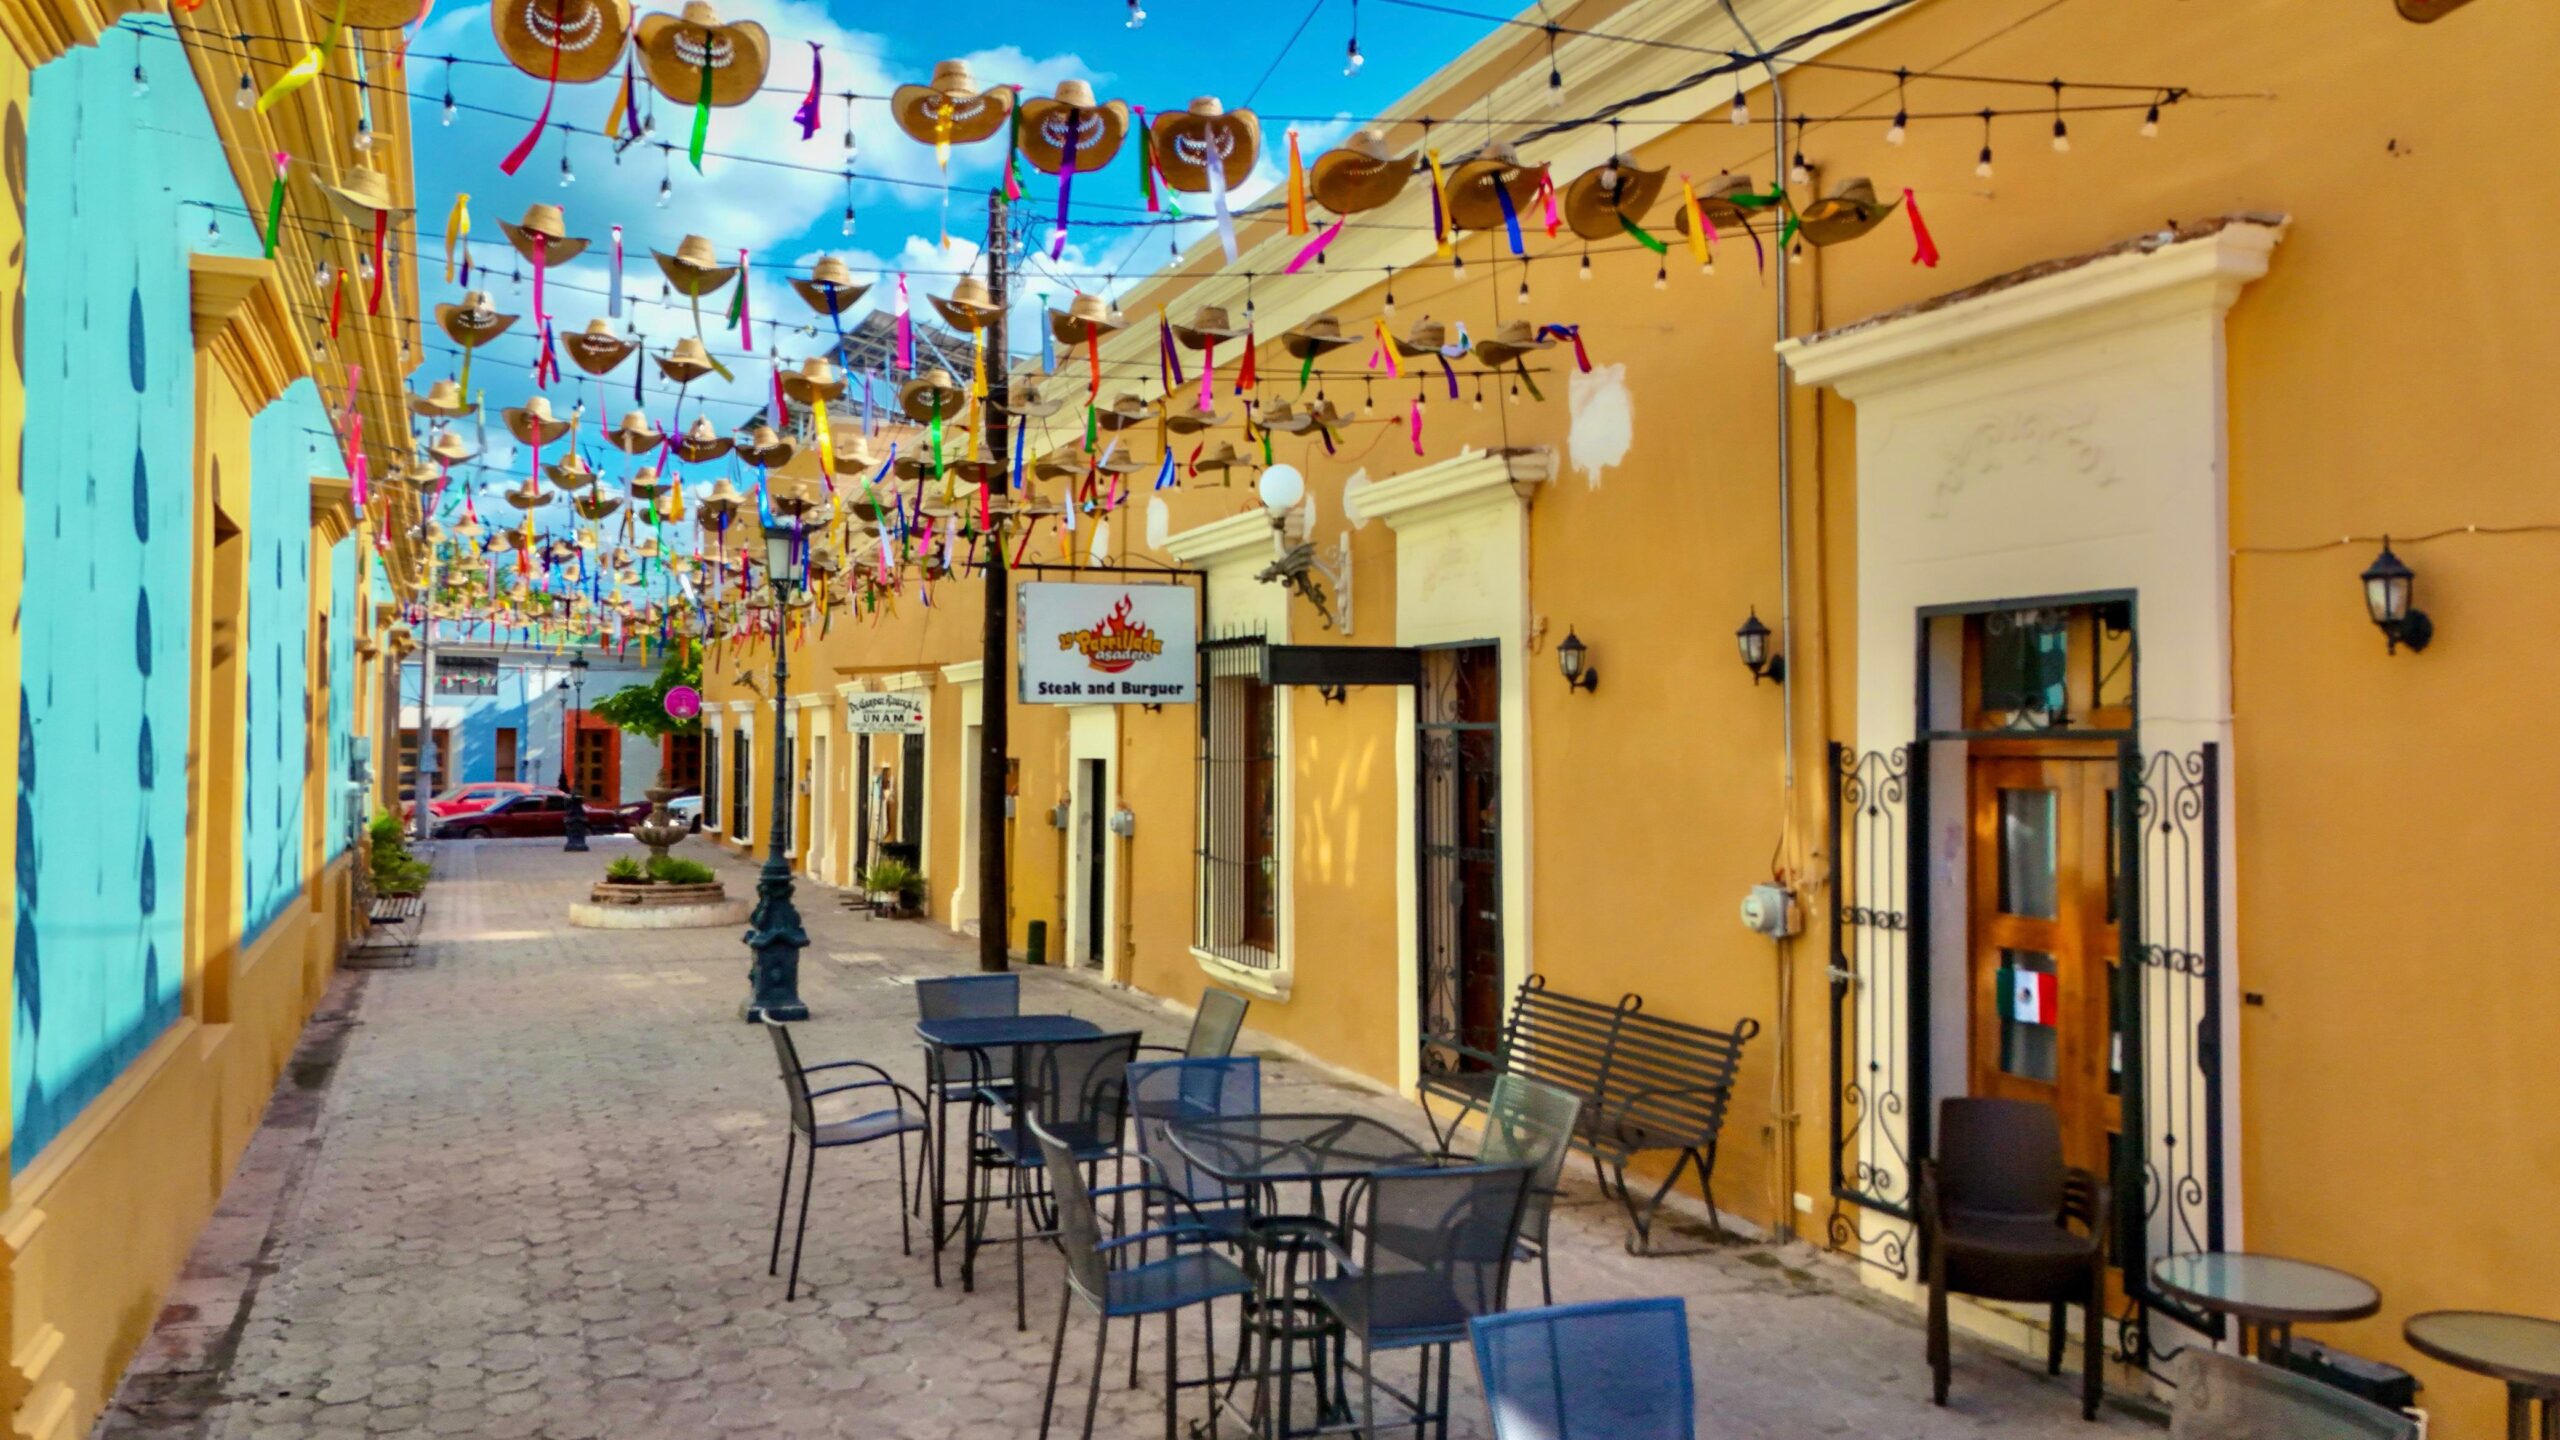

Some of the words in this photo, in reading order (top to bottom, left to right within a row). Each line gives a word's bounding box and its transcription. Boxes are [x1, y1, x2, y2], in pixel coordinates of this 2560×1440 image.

[1074, 629, 1164, 655] Parrillada
[1038, 682, 1082, 695] Steak
[1088, 682, 1115, 695] and
[1122, 682, 1184, 697] Burguer
[863, 714, 905, 723] UNAM
